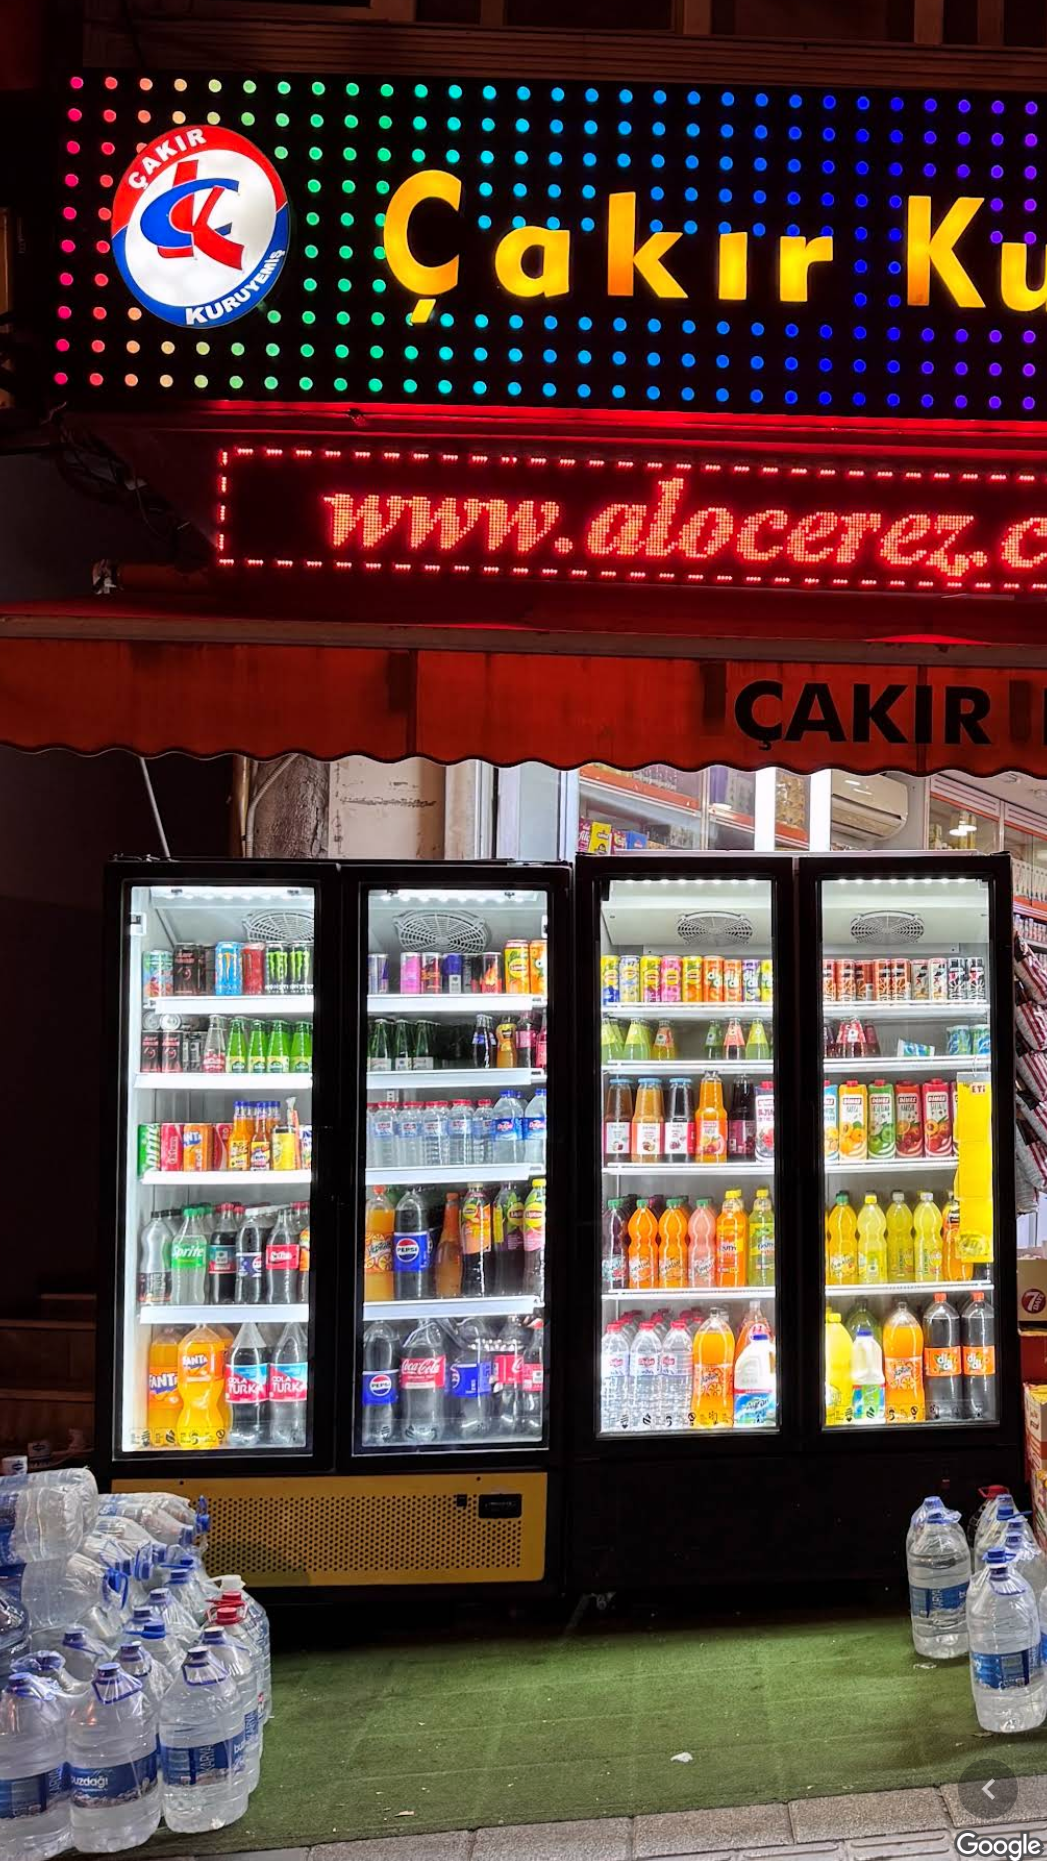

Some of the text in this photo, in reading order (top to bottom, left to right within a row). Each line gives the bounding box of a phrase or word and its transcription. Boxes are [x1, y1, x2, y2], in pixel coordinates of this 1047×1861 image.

[128, 128, 207, 190] ÇAKIR
[383, 169, 833, 324] Çakır
[733, 680, 991, 752] ÇAKIR
[172, 1245, 205, 1258] Sprite
